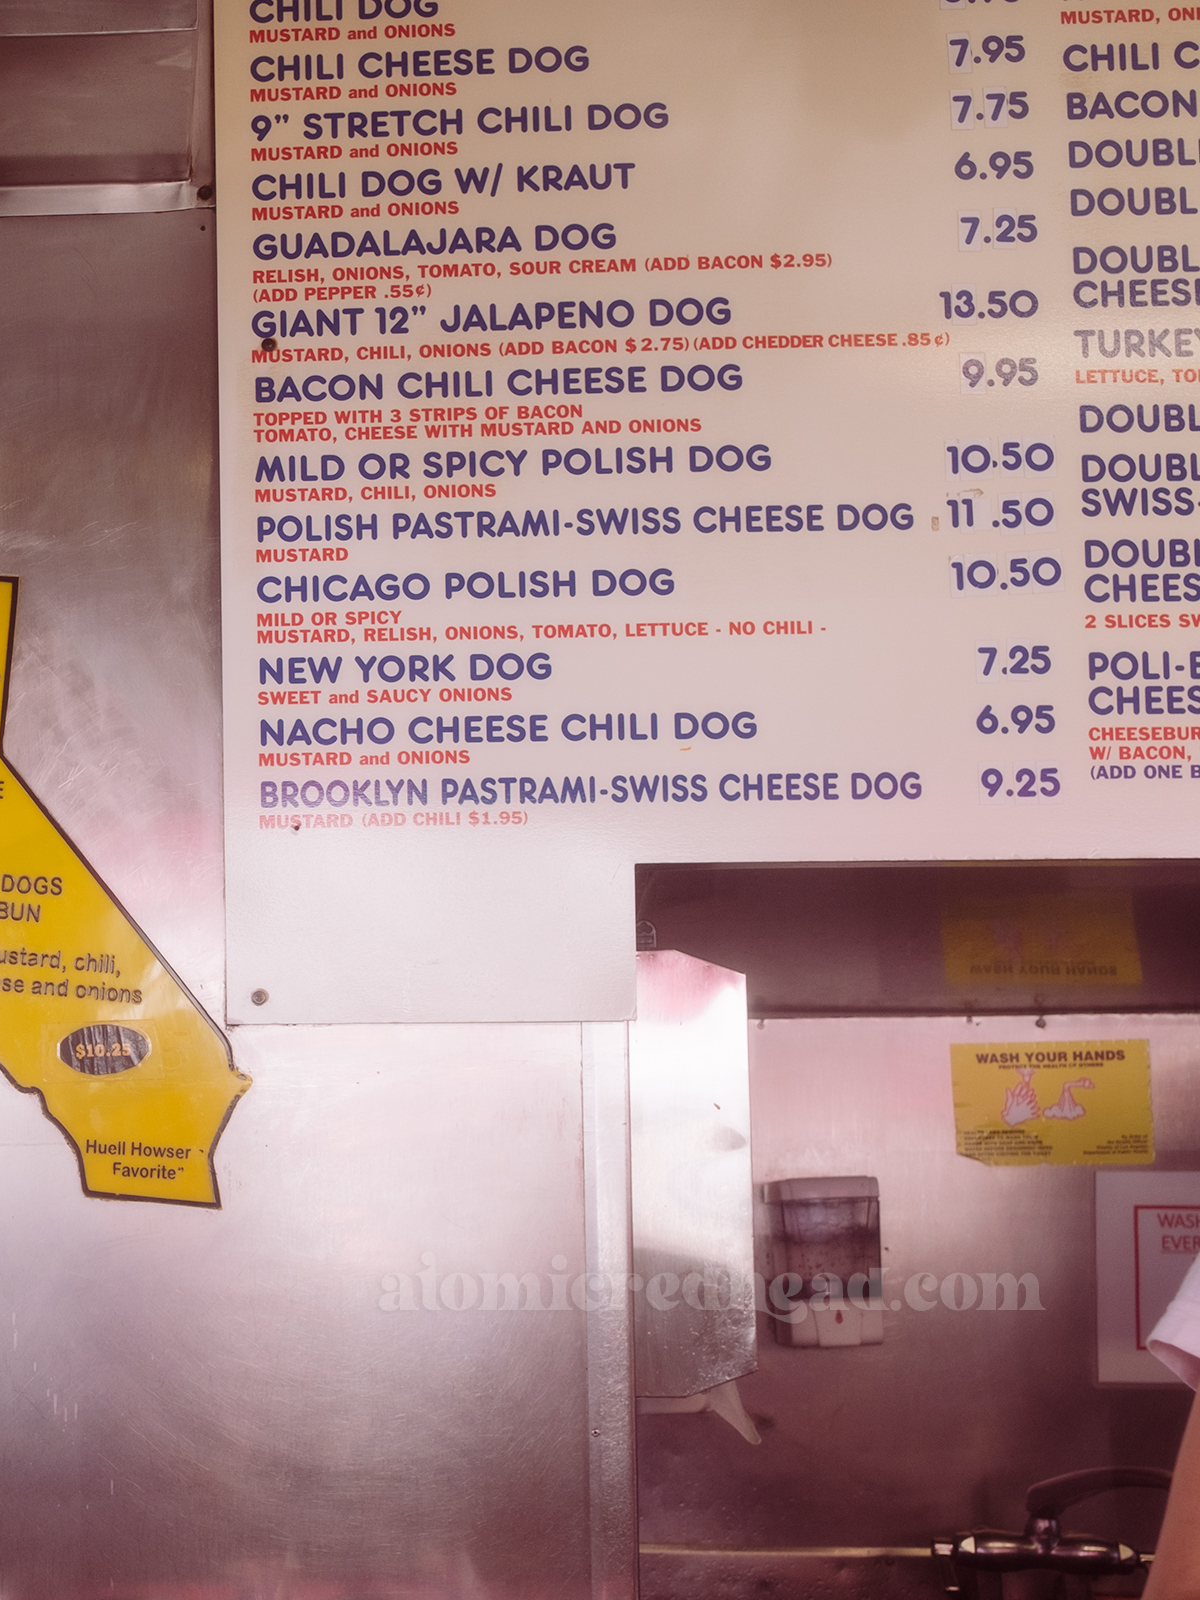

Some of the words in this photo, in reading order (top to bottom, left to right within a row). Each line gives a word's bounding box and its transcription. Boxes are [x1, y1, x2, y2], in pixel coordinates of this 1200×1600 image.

[249, 0, 343, 23] CHILI
[358, 0, 438, 20] DOG
[1061, 9, 1161, 25] MUSTARD,
[249, 27, 340, 43] MUSTARD
[347, 26, 377, 40] and
[384, 23, 455, 39] ONIONS
[250, 53, 344, 82] CHILI
[358, 48, 495, 79] CHEESE
[508, 45, 589, 74] DOG
[949, 35, 1025, 67] 7.95
[1063, 42, 1159, 72] CHILI
[952, 91, 1029, 123] 7.75
[1066, 89, 1197, 120] BACON
[303, 108, 463, 140] STRETCH
[477, 105, 572, 134] CHILI
[587, 102, 669, 130] DOG
[954, 151, 1034, 180] 6.95
[252, 172, 346, 201] CHILI
[361, 168, 442, 197] DOG
[454, 163, 503, 197] W/
[517, 163, 636, 192] KRAUT
[253, 226, 522, 261] GUADALAJARA
[535, 223, 616, 251] DOG
[960, 214, 1038, 245] 7.25
[253, 268, 324, 284] RELISH,
[332, 266, 410, 281] ONIONS,
[417, 263, 501, 278] TOMATO,
[510, 261, 561, 275] SOUR
[569, 258, 636, 274] CREAM
[645, 254, 690, 272] (ADD
[698, 255, 763, 270] BACON
[770, 253, 832, 270] $2.95)
[253, 288, 298, 303] (ADD
[305, 286, 376, 301] PEPPER
[939, 290, 1039, 320] 13.50
[252, 308, 364, 339] GIANT
[440, 299, 635, 333] JALAPENO
[649, 297, 731, 327] DOG
[251, 348, 349, 363] MUSTARD,
[357, 345, 411, 361] CHILI,
[419, 343, 491, 358] ONIONS
[499, 341, 544, 356] (ADD
[552, 339, 617, 354] BACON
[694, 336, 737, 351] (ADD
[742, 335, 824, 349] CHEDDER
[828, 333, 898, 347] CHEESE
[255, 373, 383, 403] BACON
[397, 370, 493, 399] CHILI
[507, 366, 647, 396] CHEESE
[660, 364, 743, 392] DOG
[962, 358, 1038, 388] 9.95
[253, 411, 327, 426] TOPPED
[334, 410, 382, 424] WITH
[390, 409, 401, 423] 3
[409, 407, 477, 422] STRIPS
[485, 406, 509, 420] OF
[517, 404, 582, 419] BACON
[253, 428, 337, 443] TOMATO,
[345, 425, 417, 441] CHEESE
[424, 424, 472, 438] WITH
[481, 421, 574, 437] MUSTARD
[581, 420, 621, 434] AND
[629, 418, 702, 433] ONIONS
[255, 454, 345, 483] MILD
[358, 453, 410, 480] OR
[423, 449, 528, 479] SPICY
[542, 446, 673, 476] POLISH
[689, 444, 771, 472] DOG
[946, 442, 1054, 474] 10.50
[257, 513, 378, 543] POLISH
[392, 507, 681, 540] PASTRAMI-SWISS
[693, 504, 824, 534] CHEESE
[837, 503, 914, 531] DOG
[257, 573, 430, 603] CHICAGO
[445, 570, 576, 600] POLISH
[592, 568, 675, 596] DOG
[951, 557, 1062, 591] 10.50
[257, 629, 355, 645] MUSTARD,
[364, 627, 437, 643] RELISH,
[445, 625, 524, 642] ONIONS,
[532, 623, 617, 640] TOMATO,
[625, 622, 709, 637] LETTUCE
[729, 621, 755, 635] NO
[763, 621, 812, 635] CHILI
[1085, 615, 1096, 628] 2
[1105, 614, 1171, 628] SLICES
[259, 656, 343, 685] NEW
[354, 654, 456, 683] YORK
[470, 652, 552, 681] DOG
[977, 645, 1051, 676] 7.25
[258, 691, 321, 705] SWEET
[329, 690, 359, 704] and
[367, 689, 431, 703] SAUCY
[439, 687, 512, 702] ONIONS
[260, 717, 395, 746] NACHO
[408, 714, 549, 744] CHEESE
[561, 712, 658, 741] CHILI
[674, 711, 757, 740] DOG
[976, 704, 1055, 734] 6.95
[1089, 746, 1111, 760] W/
[1119, 746, 1192, 761] BACON,
[981, 767, 1061, 797] 9.25
[1091, 765, 1136, 780] (ADD
[1144, 765, 1183, 779] ONE
[261, 779, 427, 808] BROOKLYN
[441, 774, 708, 805] PASTRAMI-SWISS
[719, 772, 839, 802] CHEESE
[851, 771, 922, 800] DOG
[260, 814, 353, 831] MUSTARD
[363, 813, 406, 827] (ADD
[413, 812, 460, 825] CHILI
[469, 811, 528, 826] $1.95)
[1, 874, 64, 897] DOGS
[73, 952, 122, 978] chili,
[30, 978, 70, 998] and
[75, 983, 143, 1005] onions
[74, 1042, 132, 1060] $10.25
[976, 1053, 1020, 1064] WASH
[1025, 1051, 1068, 1063] YOUR
[1072, 1049, 1126, 1061] HANDS
[85, 1138, 127, 1157] Huell
